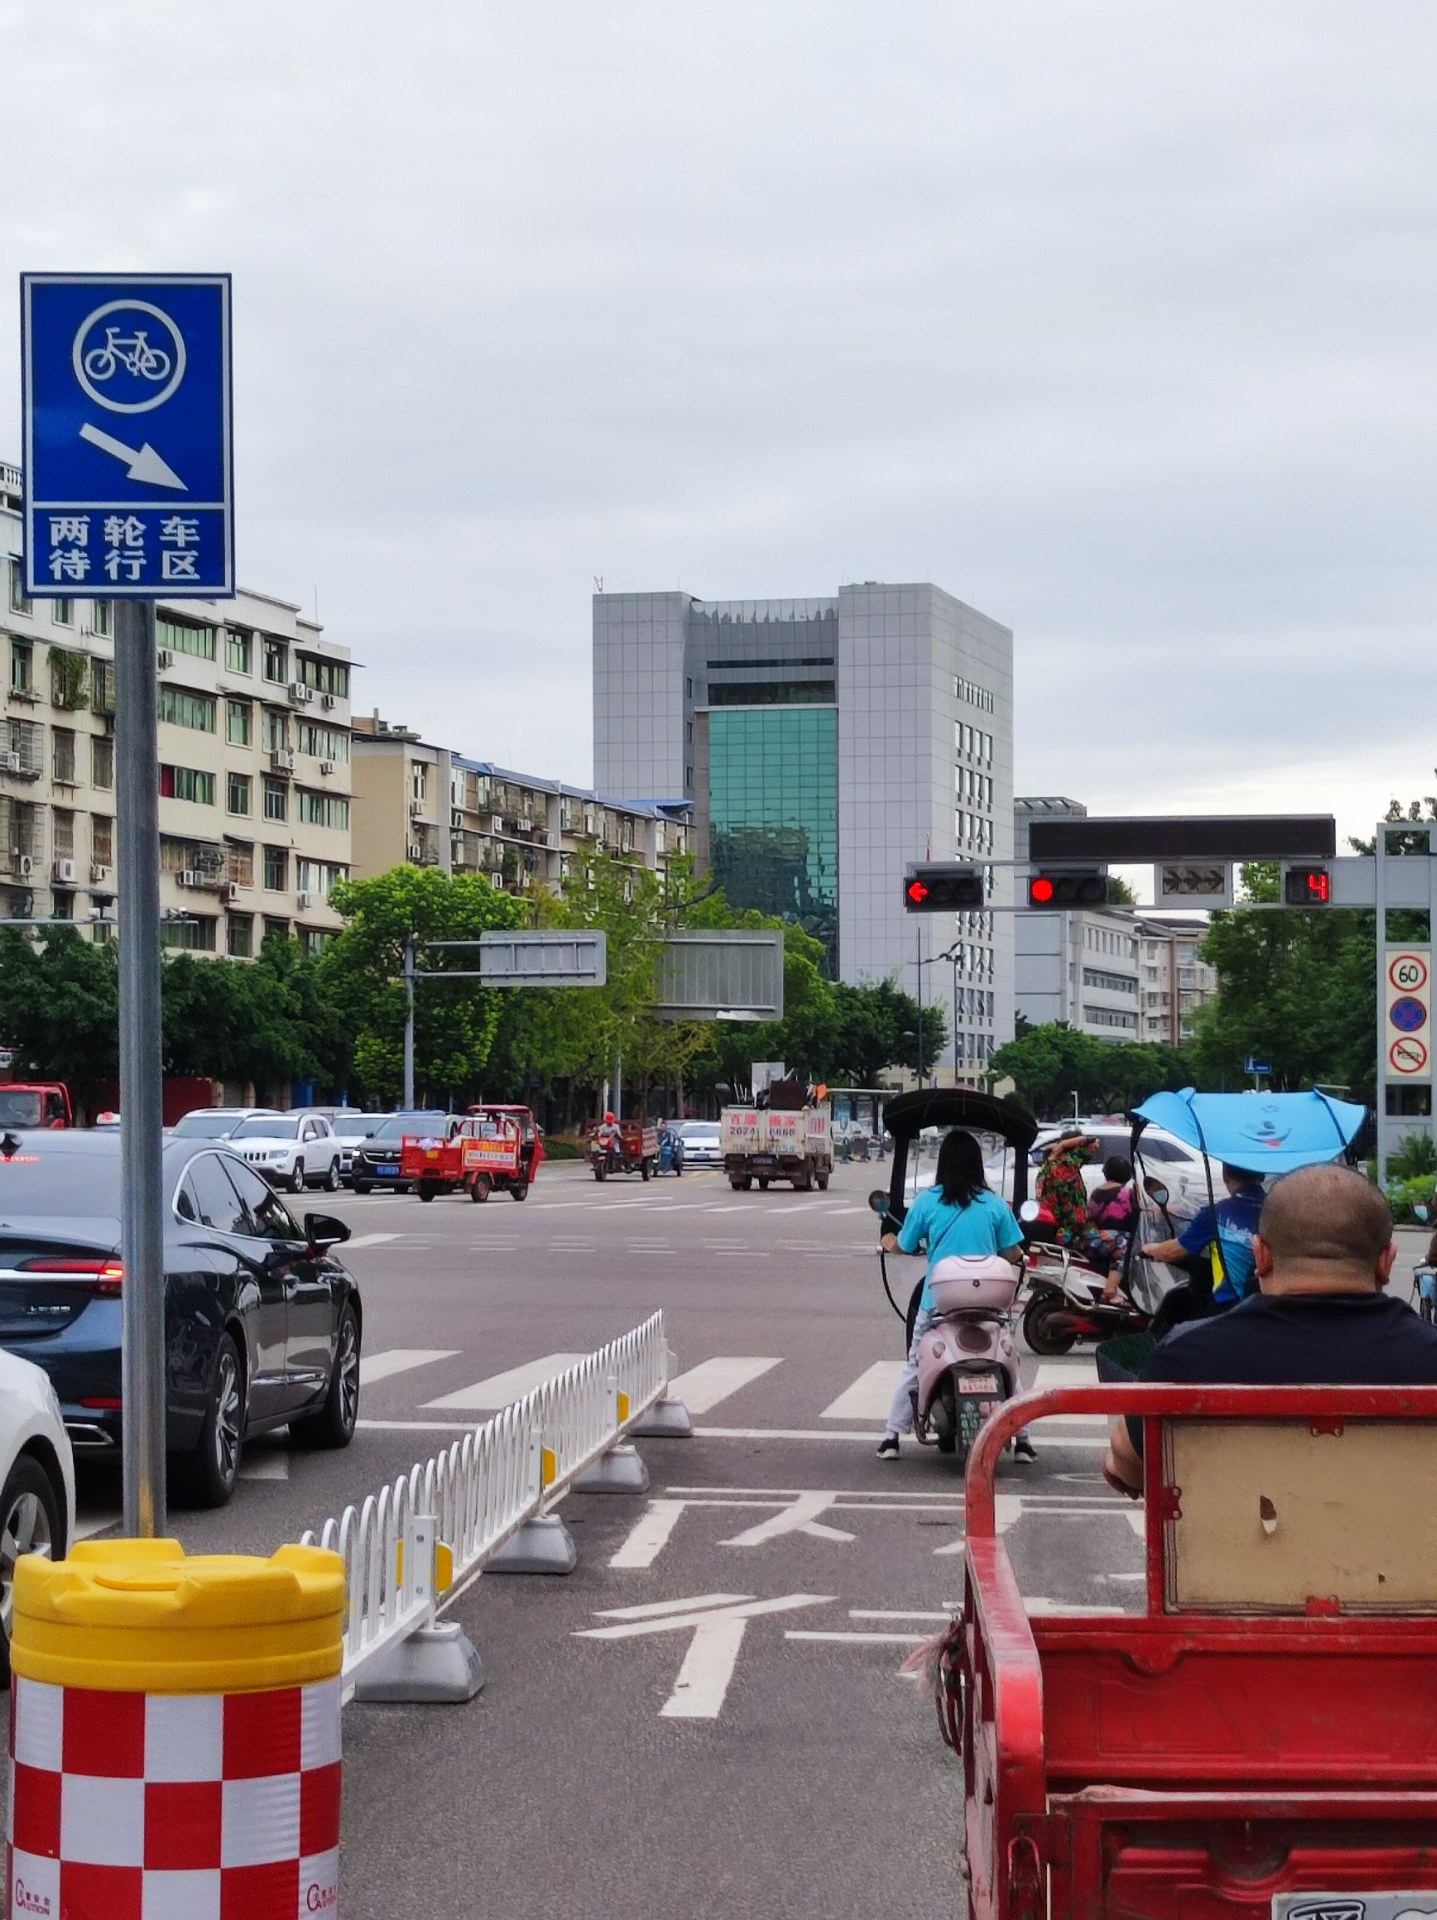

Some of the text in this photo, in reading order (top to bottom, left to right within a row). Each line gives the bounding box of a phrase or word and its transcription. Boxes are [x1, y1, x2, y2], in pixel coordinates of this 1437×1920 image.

[48, 514, 201, 547] 两轮车
[48, 549, 201, 580] 待行区
[1309, 874, 1328, 902] 4
[1398, 964, 1419, 983] 60
